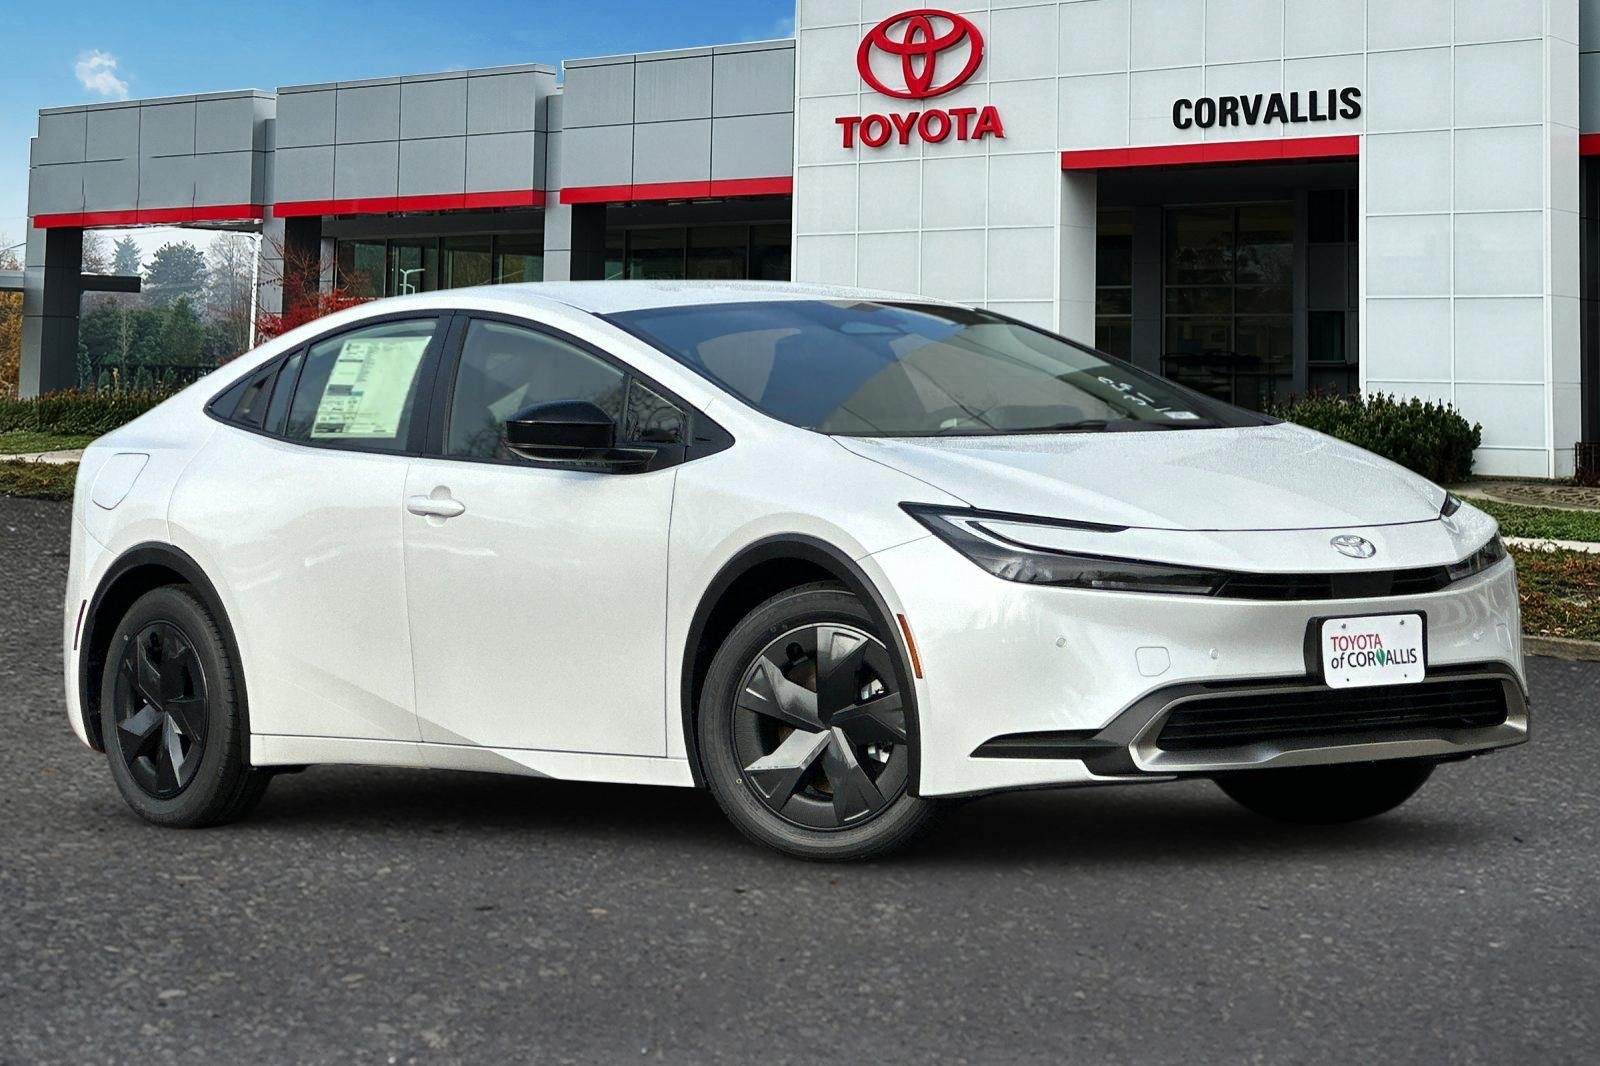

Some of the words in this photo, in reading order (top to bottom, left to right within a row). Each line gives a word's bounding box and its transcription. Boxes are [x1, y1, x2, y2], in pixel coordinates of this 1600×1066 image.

[1172, 87, 1362, 129] CORVALLIS
[835, 105, 1005, 149] TOYOTA
[1331, 633, 1383, 652] TOYOTA
[1331, 652, 1345, 669] of
